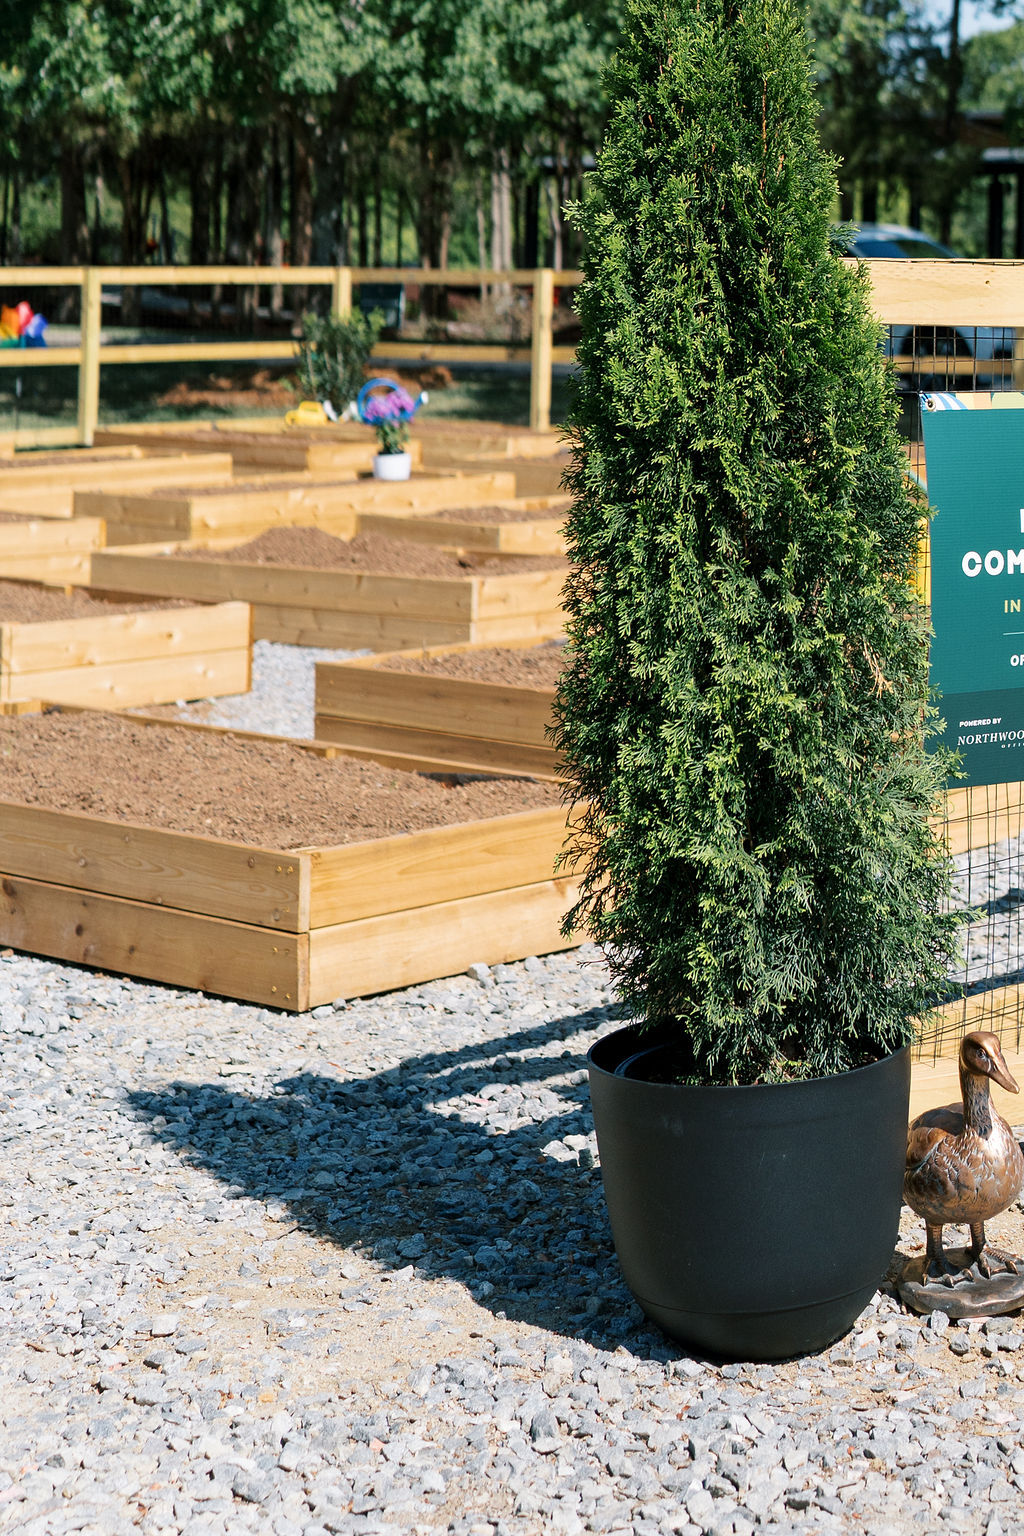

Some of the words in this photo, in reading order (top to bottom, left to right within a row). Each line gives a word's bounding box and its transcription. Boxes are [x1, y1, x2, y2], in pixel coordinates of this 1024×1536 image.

[1004, 599, 1021, 613] IN
[959, 718, 991, 728] POWERED
[992, 717, 1002, 725] BY
